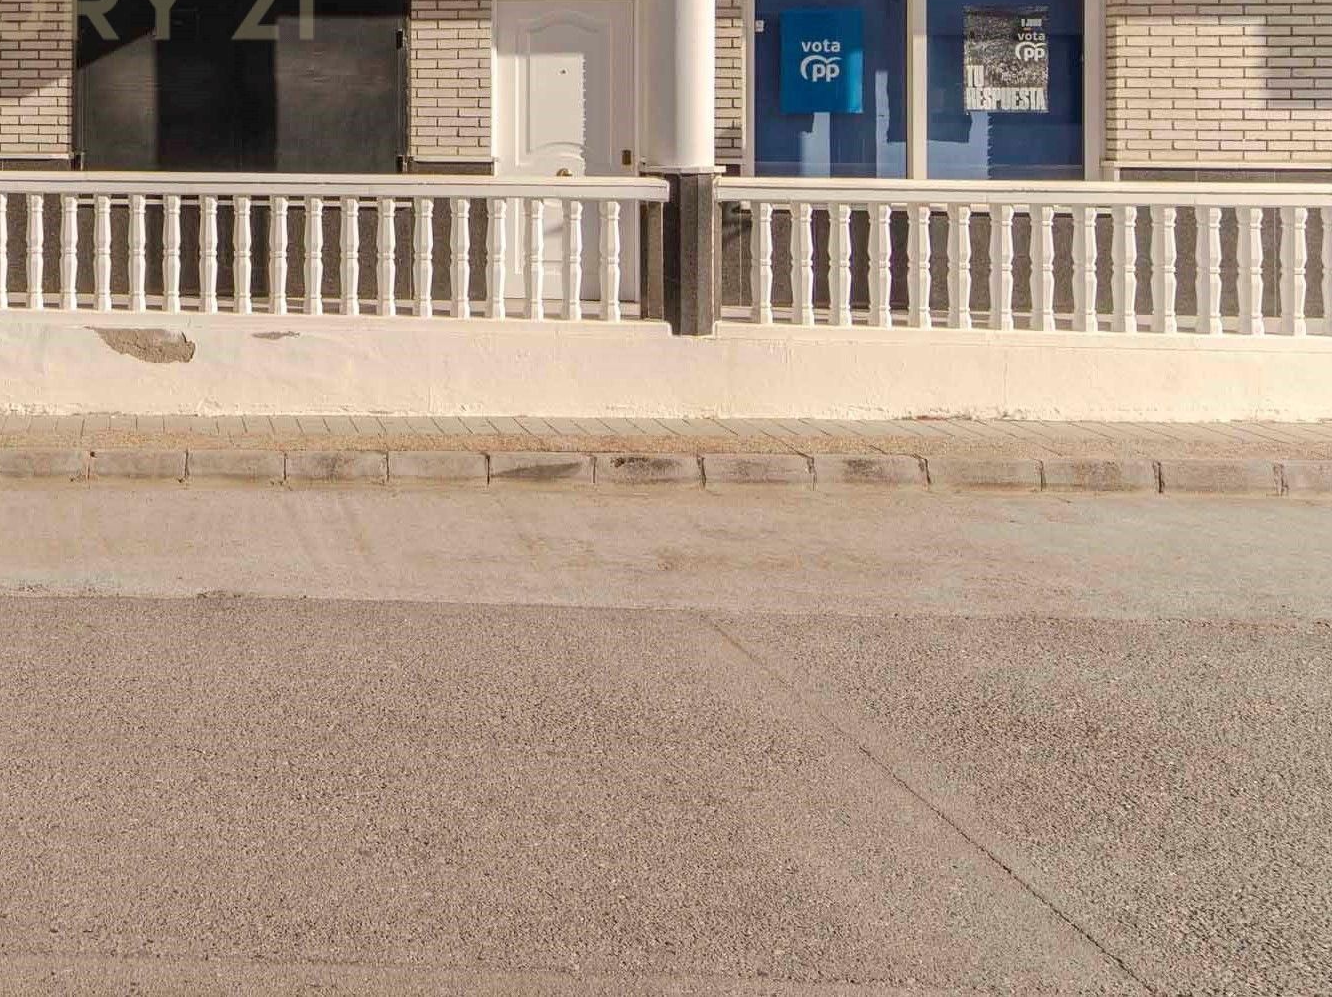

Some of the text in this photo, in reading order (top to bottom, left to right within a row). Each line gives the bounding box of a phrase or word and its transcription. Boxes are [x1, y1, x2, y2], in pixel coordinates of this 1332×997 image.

[801, 38, 841, 53] vota
[1017, 32, 1046, 41] vota
[967, 65, 984, 88] TU
[966, 87, 1047, 110] RESPUESTA
